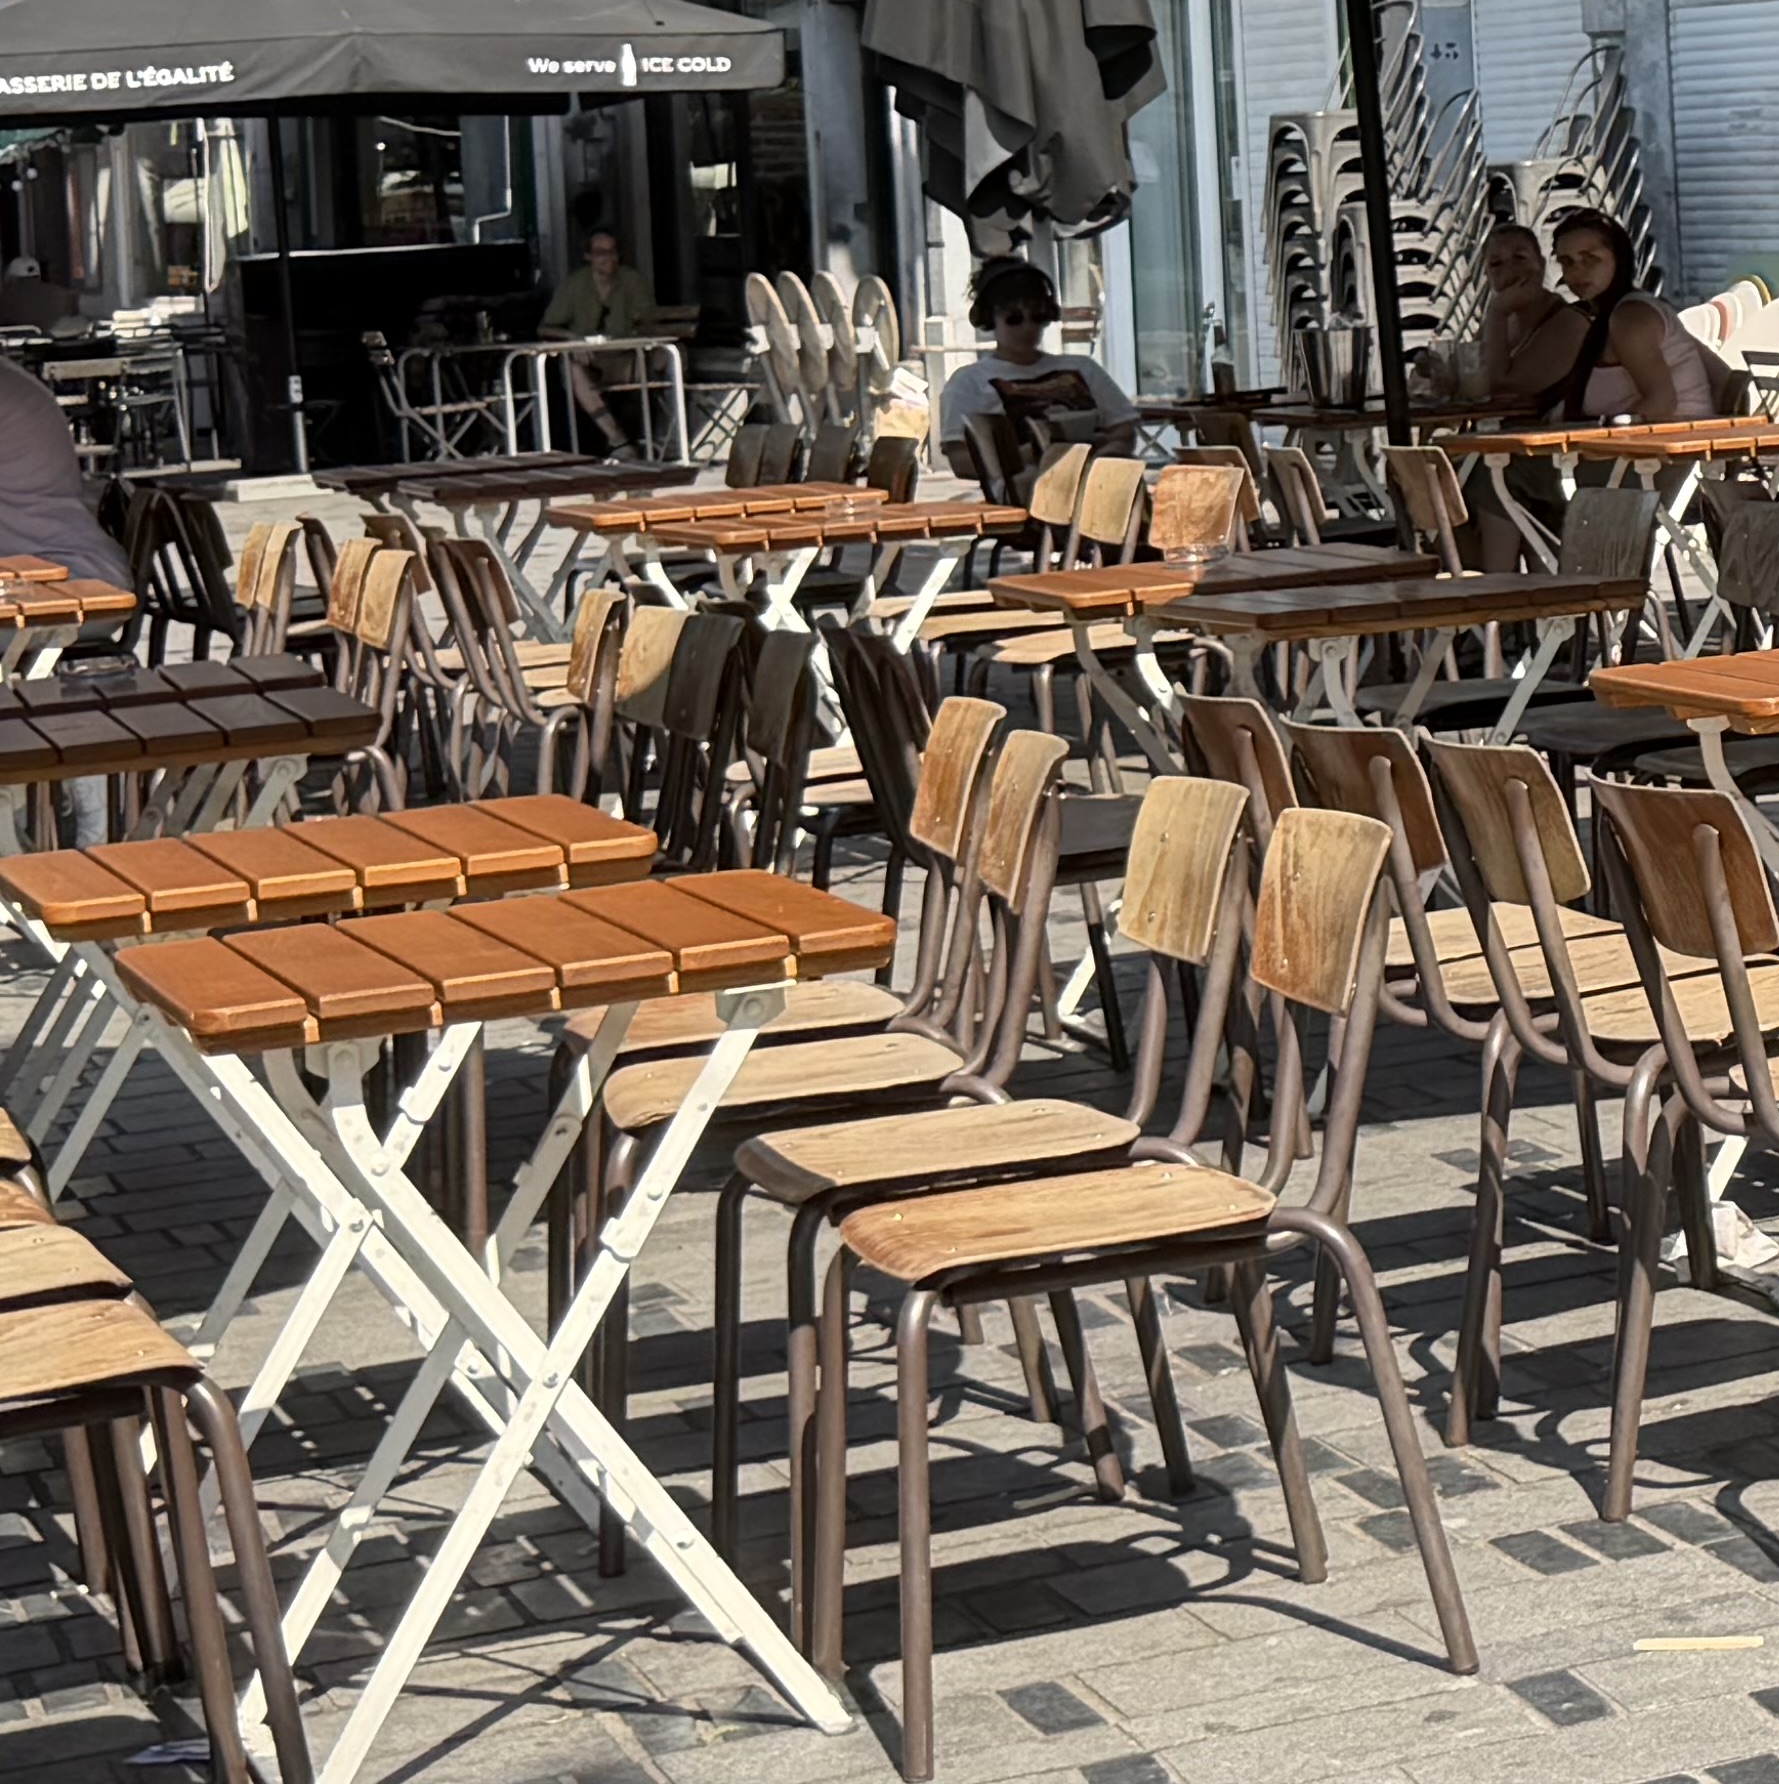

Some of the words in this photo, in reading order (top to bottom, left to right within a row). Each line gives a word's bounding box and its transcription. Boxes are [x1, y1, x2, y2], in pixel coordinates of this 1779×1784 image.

[91, 72, 121, 91] DE
[125, 61, 235, 89] L'ÉGALITÉ
[527, 57, 559, 73] We
[562, 60, 617, 74] serve
[641, 57, 674, 72] ICE
[676, 56, 731, 72] COLD
